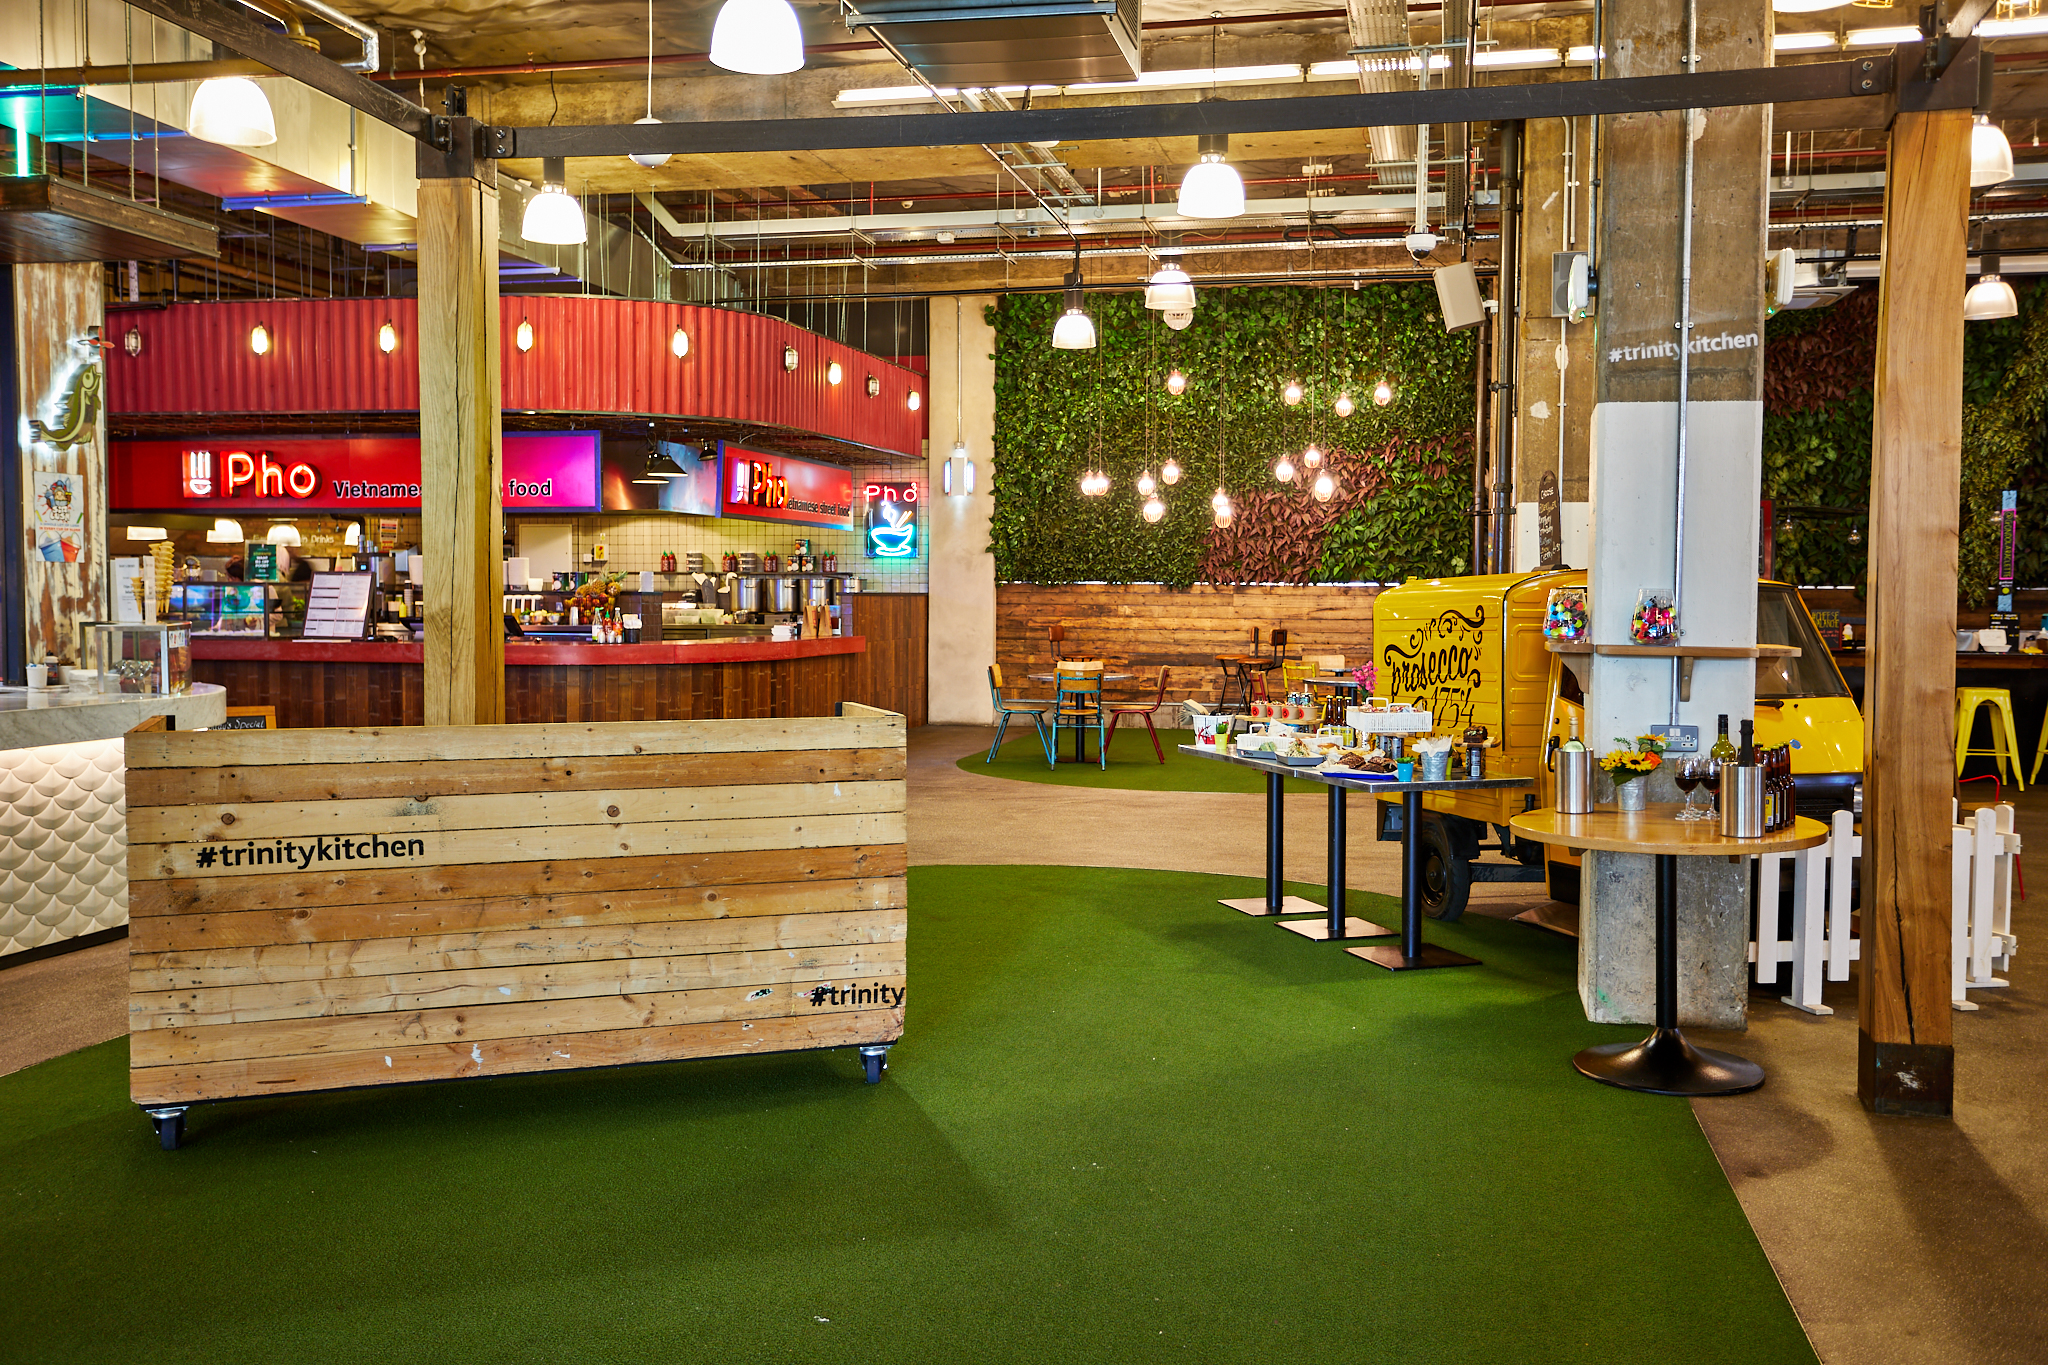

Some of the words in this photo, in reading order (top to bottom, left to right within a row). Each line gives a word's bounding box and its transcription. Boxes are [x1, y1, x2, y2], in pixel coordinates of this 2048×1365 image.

[1608, 331, 1759, 362] #trinitykitchen
[219, 451, 319, 499] Pho
[333, 480, 422, 498] Vietname
[508, 478, 552, 497] food
[785, 497, 818, 513] ietnamese
[819, 501, 836, 515] street
[837, 503, 851, 517] food
[1391, 645, 1473, 703] prosecco
[1431, 687, 1475, 729] 1754
[235, 718, 264, 729] Special
[196, 834, 424, 870] #trinitykitchen
[810, 982, 905, 1008] #trinity
